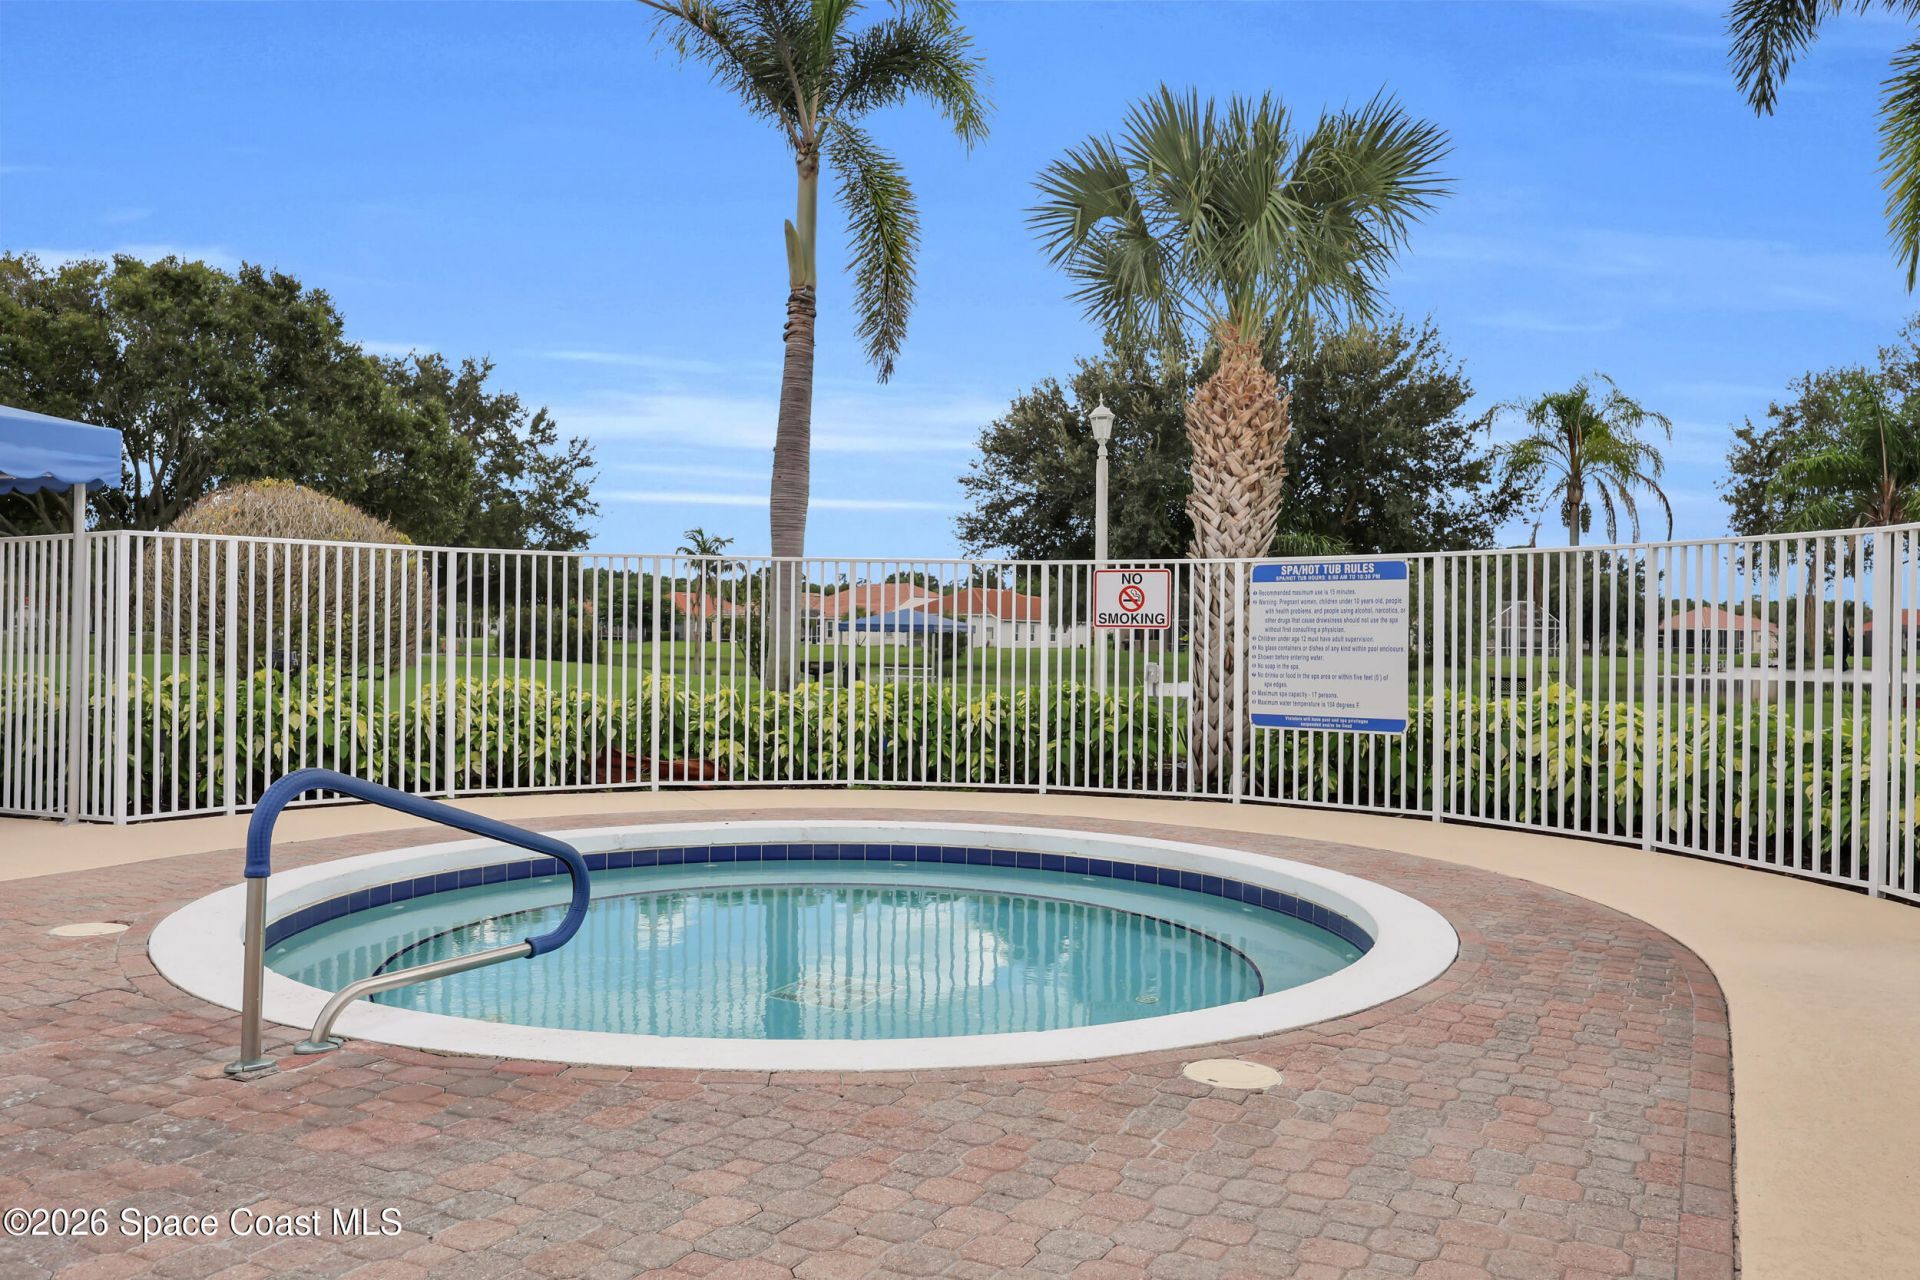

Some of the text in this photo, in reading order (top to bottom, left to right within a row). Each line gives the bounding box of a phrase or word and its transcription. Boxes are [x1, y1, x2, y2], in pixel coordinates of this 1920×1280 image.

[1281, 563, 1375, 575] SPA/HOT TUB RULES
[1122, 573, 1142, 584] NO
[1098, 613, 1165, 624] SMOKING
